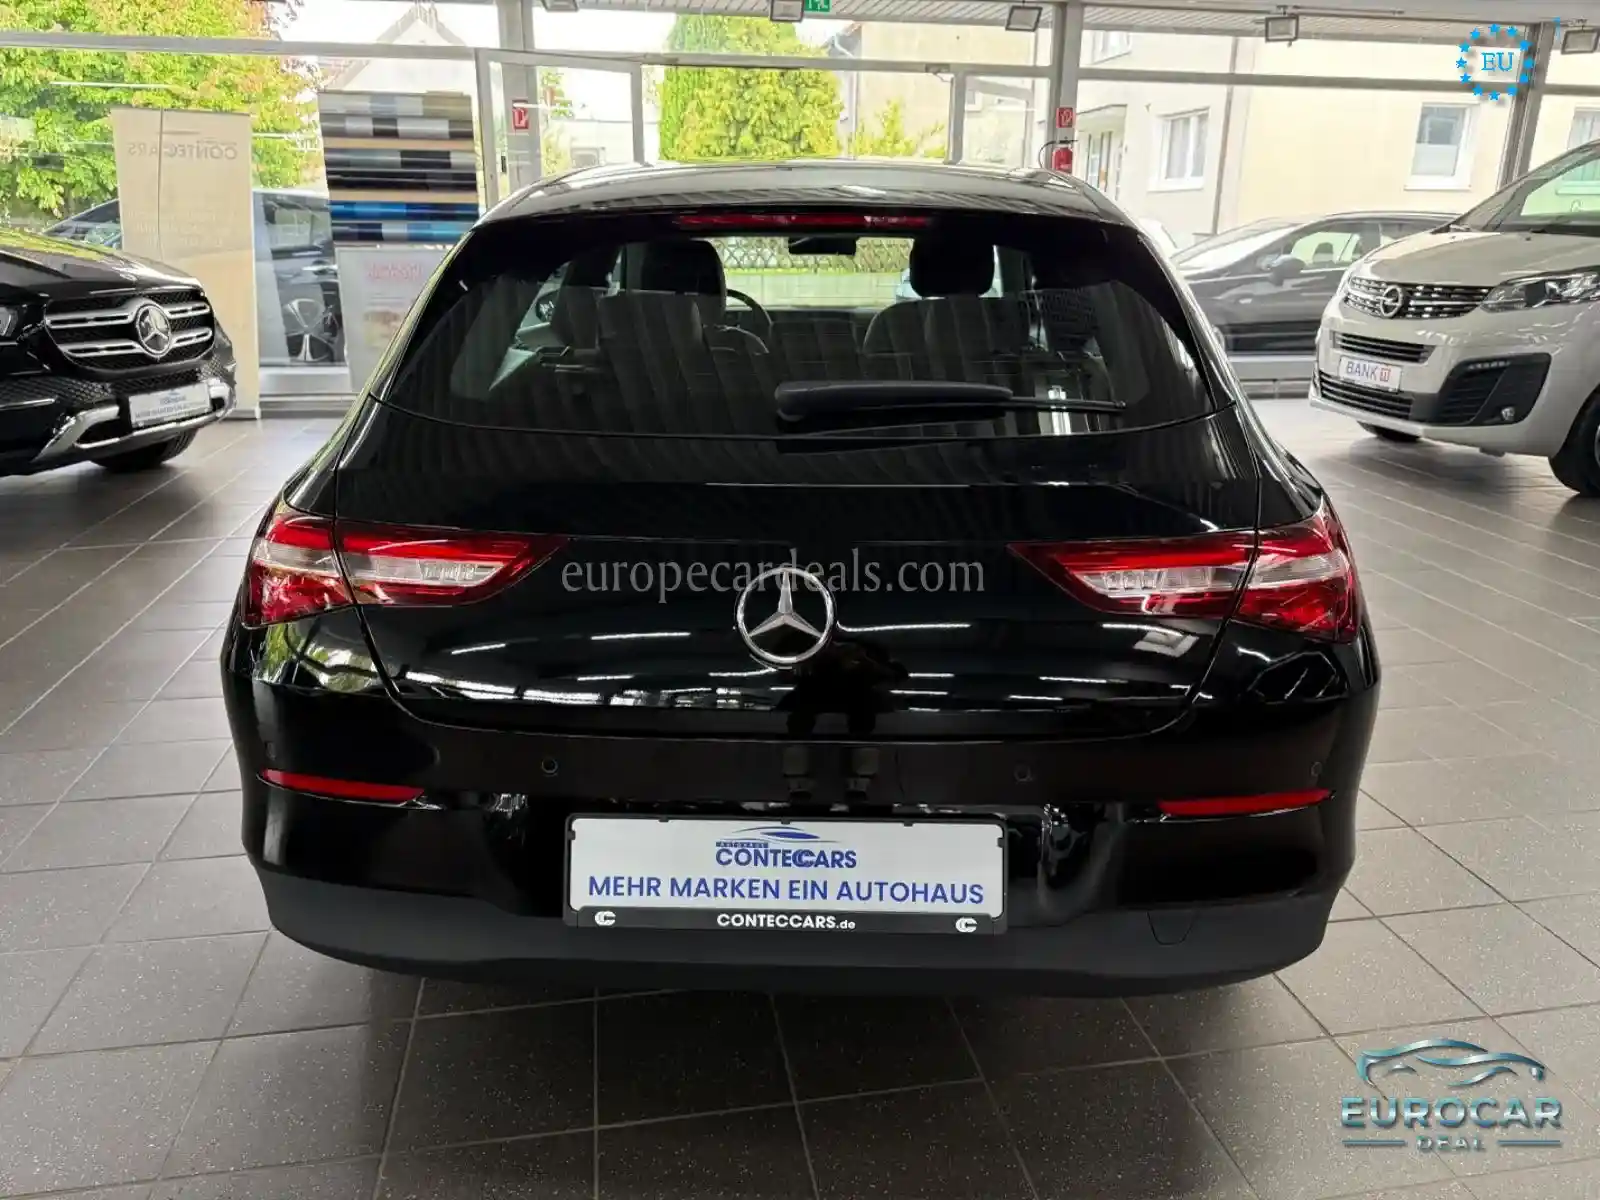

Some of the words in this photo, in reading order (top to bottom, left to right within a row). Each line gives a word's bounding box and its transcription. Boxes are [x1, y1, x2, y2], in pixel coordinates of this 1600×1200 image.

[1347, 361, 1378, 381] BANK
[588, 876, 662, 897] MEHR
[670, 877, 780, 899] MARKEN
[789, 880, 828, 900] EIN
[836, 881, 985, 904] AUTOHAUS
[717, 914, 856, 930] CONTECCARS.de
